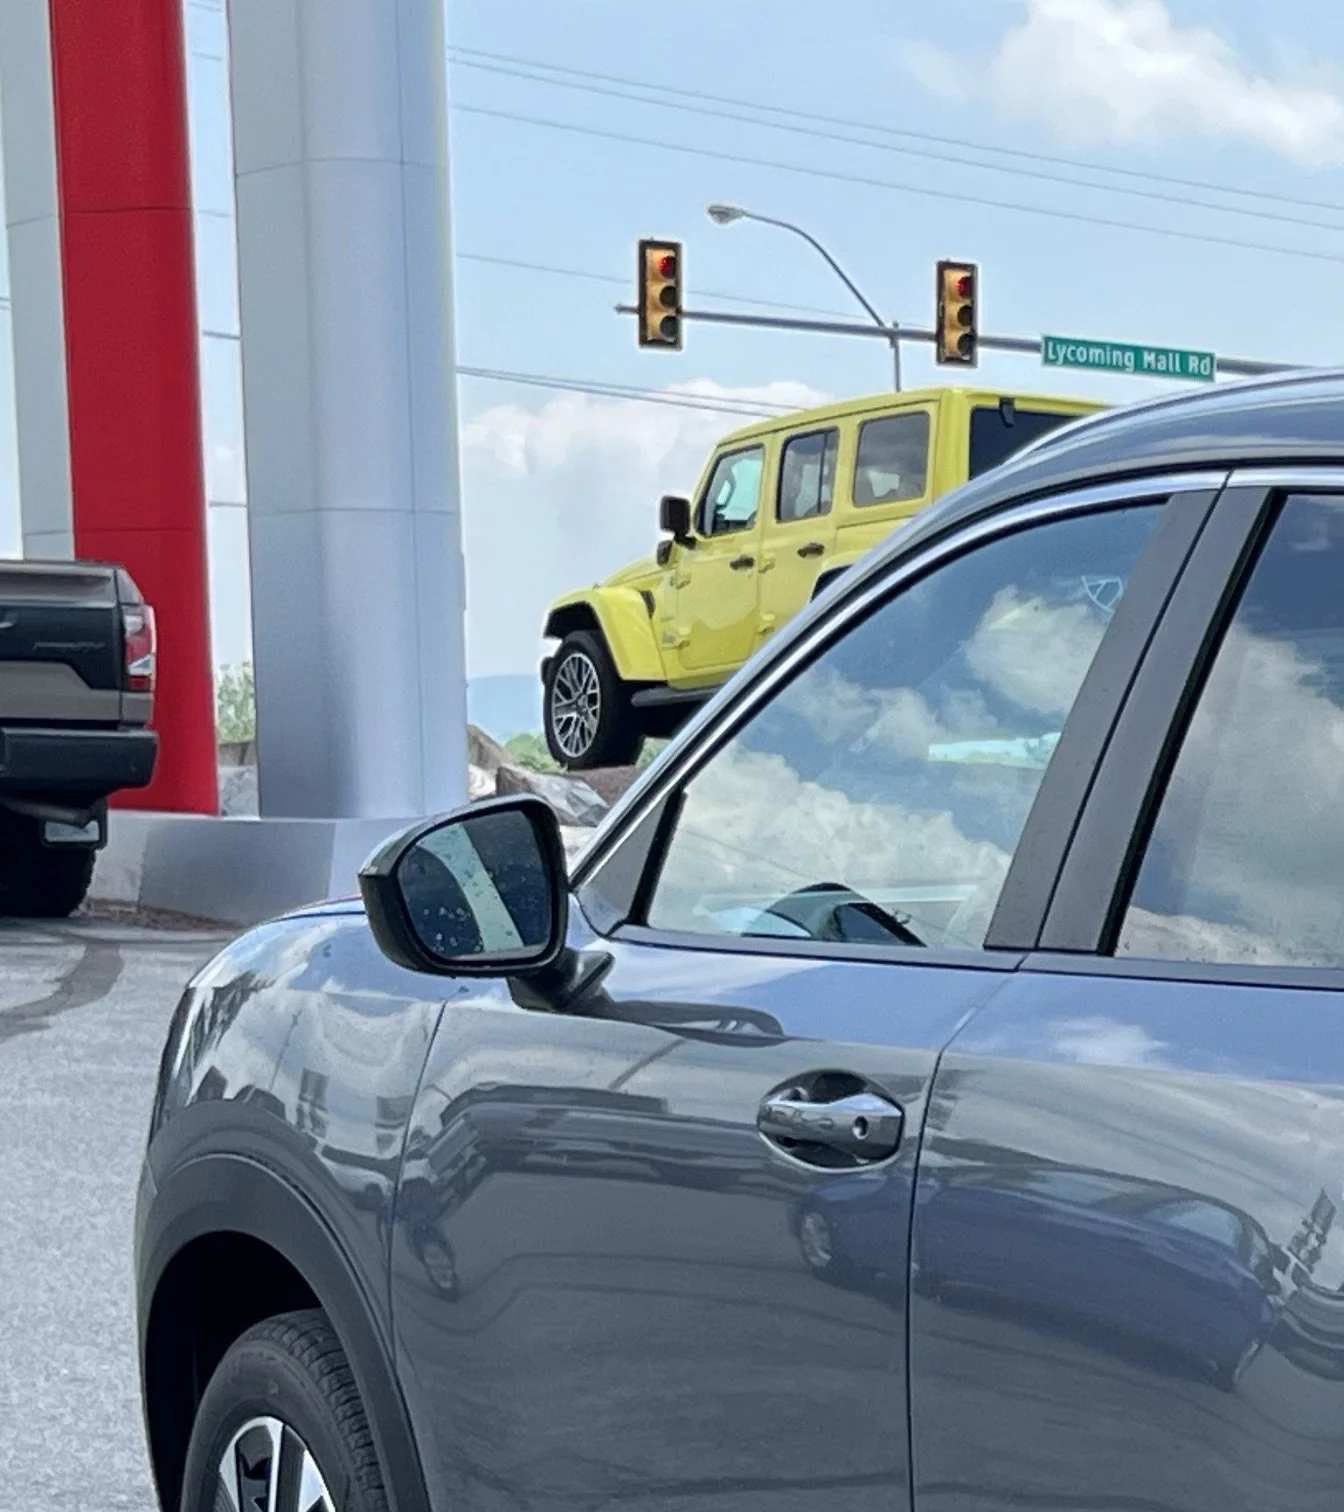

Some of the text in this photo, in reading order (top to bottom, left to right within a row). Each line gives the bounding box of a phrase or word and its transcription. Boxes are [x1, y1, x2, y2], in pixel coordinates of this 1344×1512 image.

[1048, 341, 1211, 376] Lycoming Mall Rd
